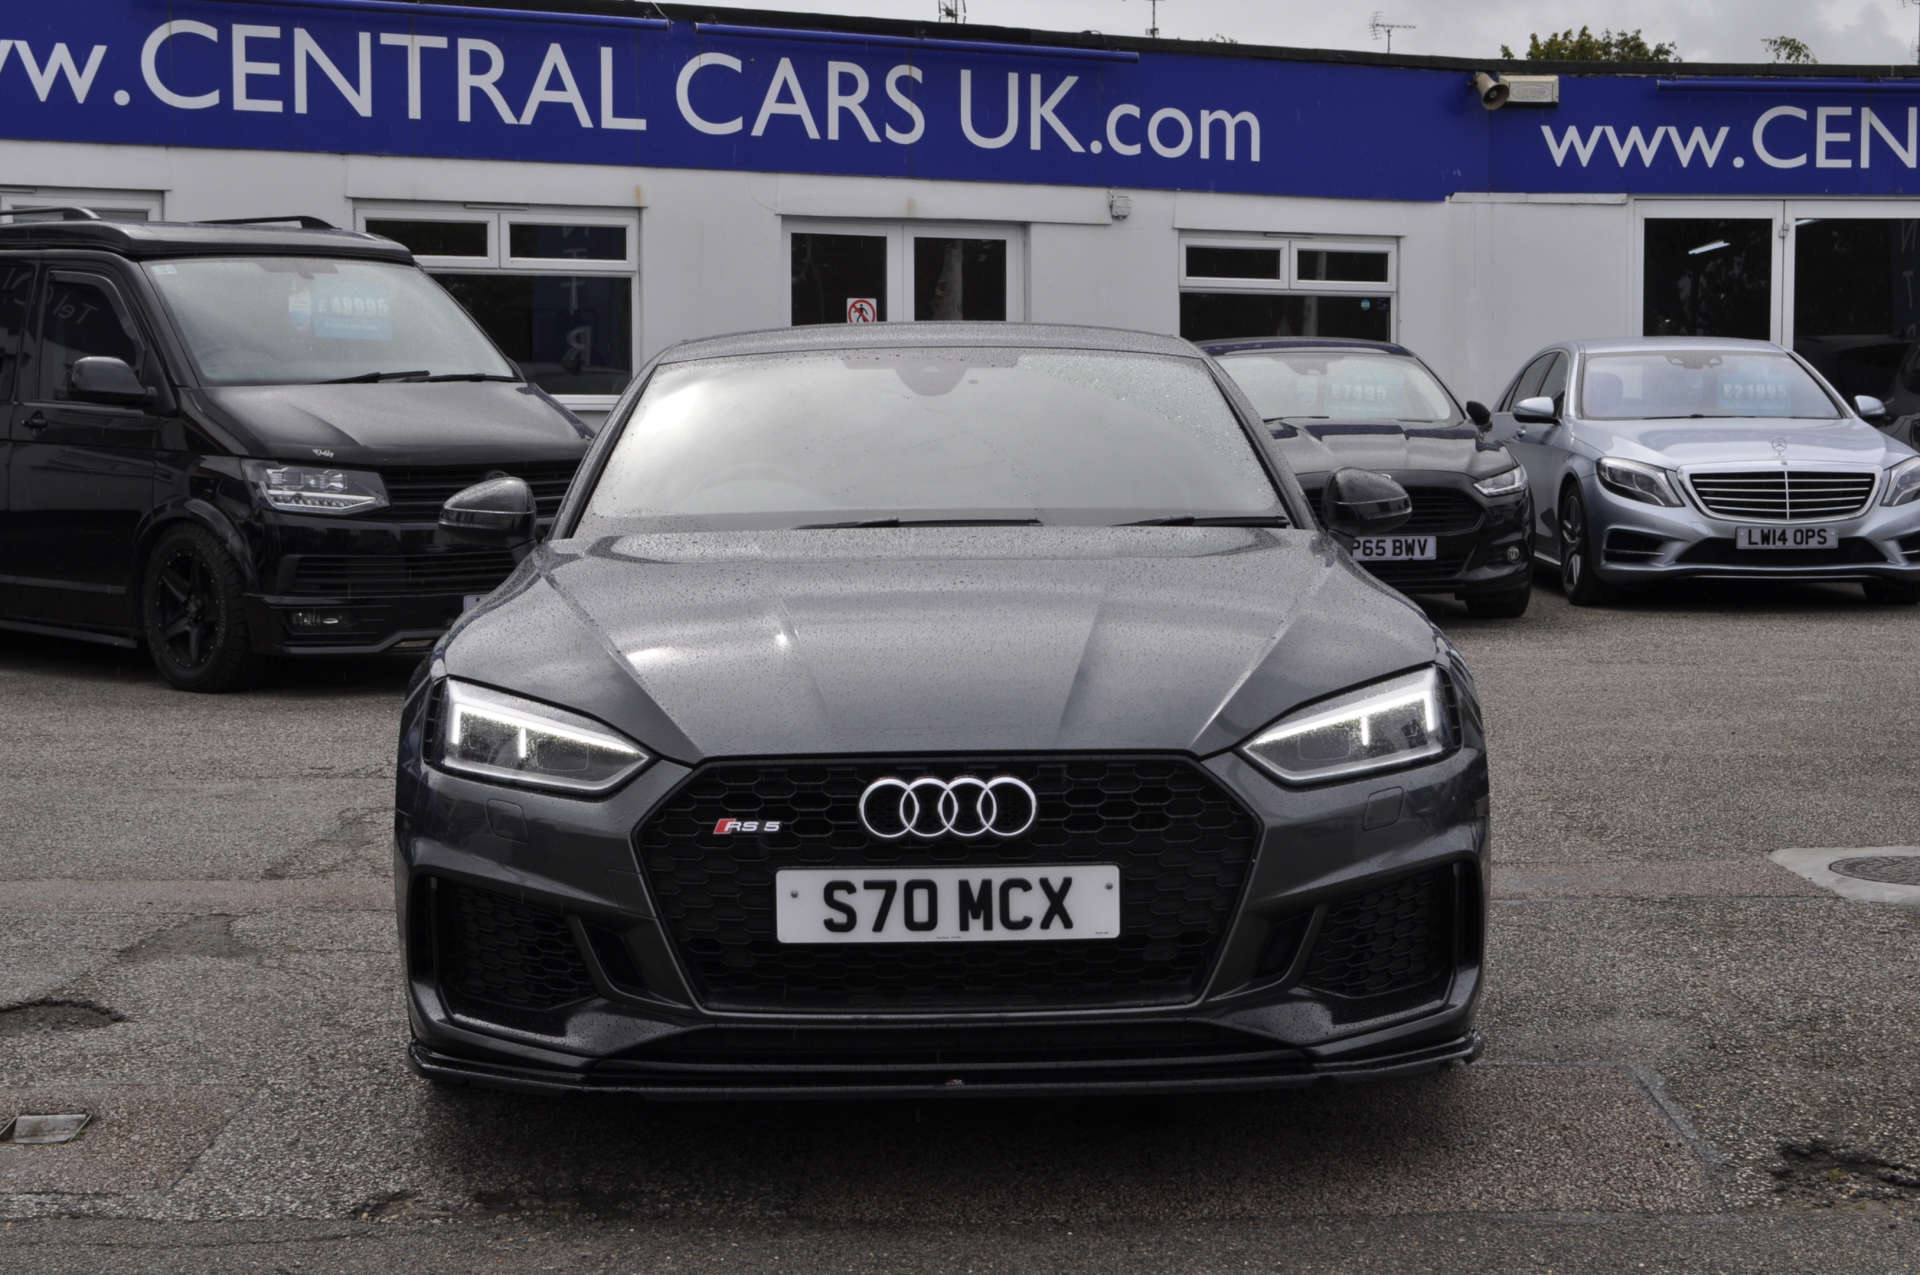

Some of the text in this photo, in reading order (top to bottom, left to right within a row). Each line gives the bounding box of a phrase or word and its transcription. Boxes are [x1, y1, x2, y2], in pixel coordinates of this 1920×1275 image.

[0, 19, 1261, 163] w.CENTRAL CARS UK.com
[1540, 105, 1918, 169] www.CEN
[1392, 538, 1428, 557] BWV
[1748, 528, 1828, 545] LW14 OPS
[724, 820, 781, 832] RS 5
[823, 876, 1074, 934] S70 MCX
